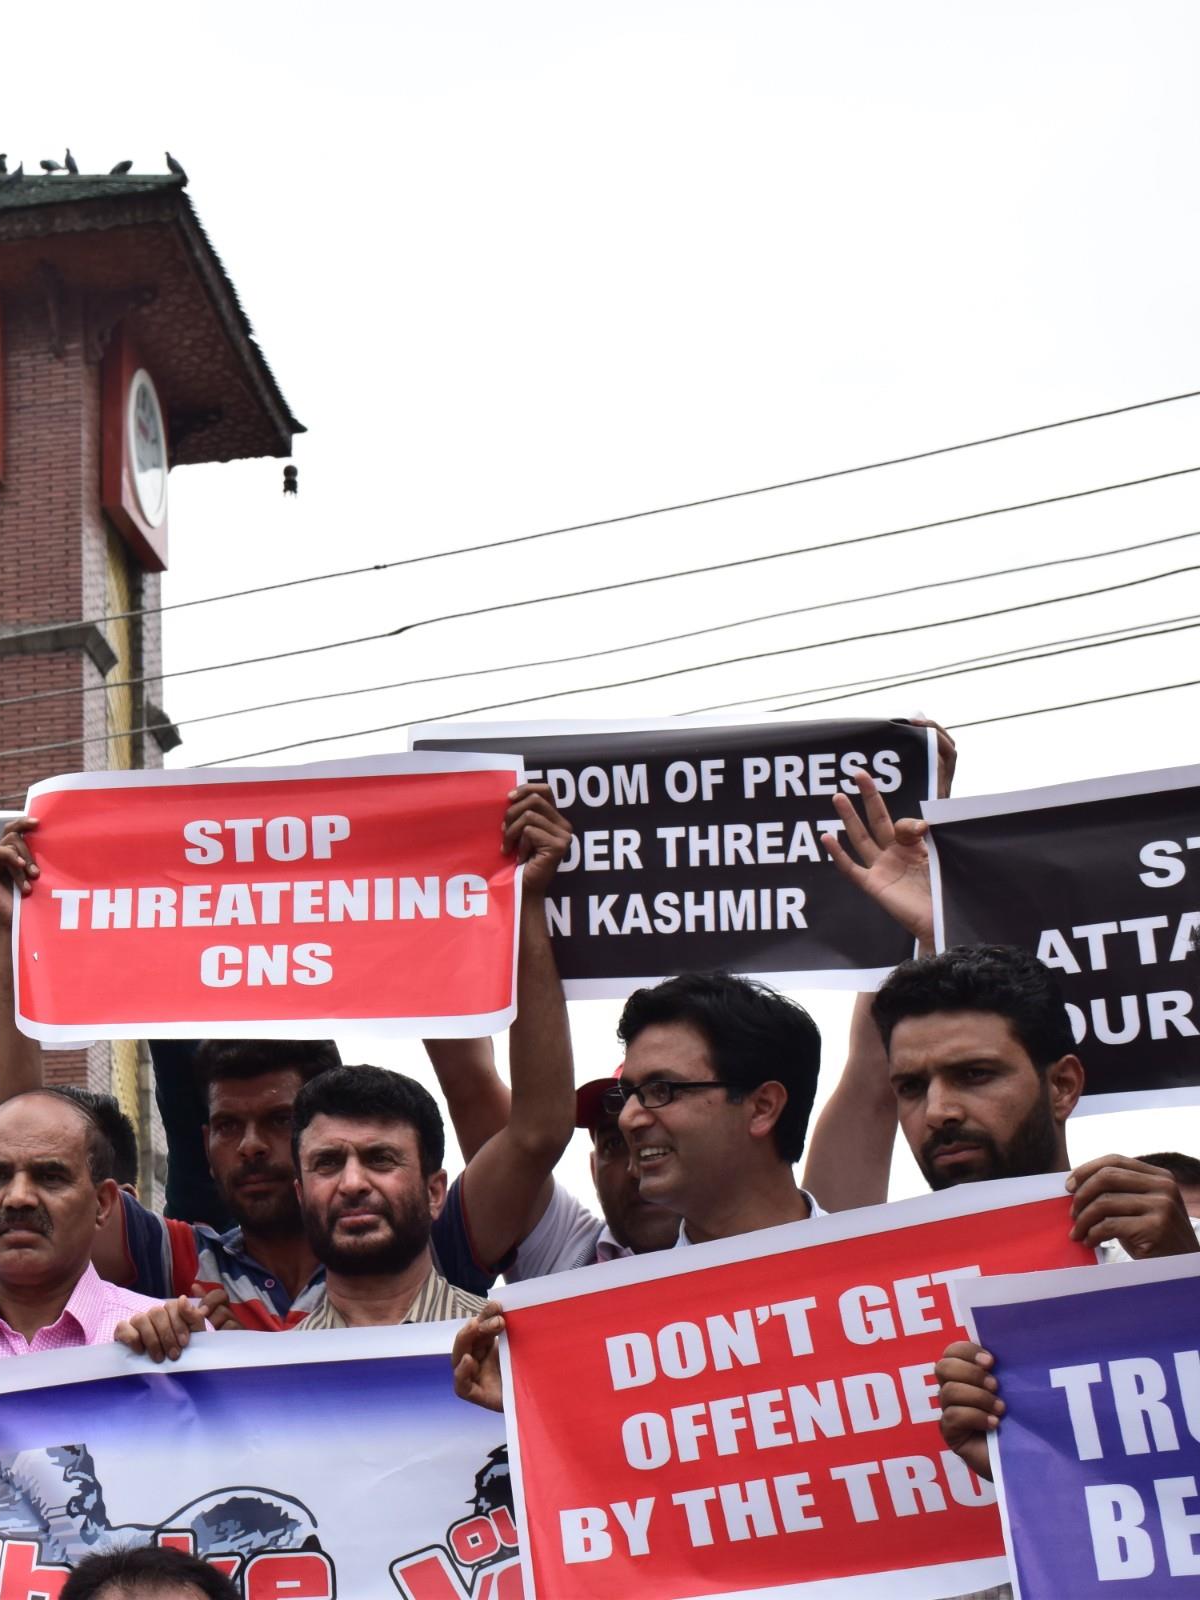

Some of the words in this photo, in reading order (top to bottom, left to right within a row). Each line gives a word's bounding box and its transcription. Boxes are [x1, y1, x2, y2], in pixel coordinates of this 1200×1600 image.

[666, 760, 724, 802] OF
[744, 751, 902, 799] PRESS
[184, 814, 351, 865] STOP
[657, 819, 846, 868] THREAT
[51, 874, 489, 930] THREATENING
[589, 888, 808, 936] KASHMIR
[200, 942, 333, 988] CNS
[605, 1296, 817, 1391] DON'T
[838, 1264, 981, 1345] GET
[621, 1361, 944, 1470] OFFENDE
[558, 1497, 656, 1565] BY
[671, 1472, 824, 1548] THE
[829, 1449, 998, 1523] TRU
